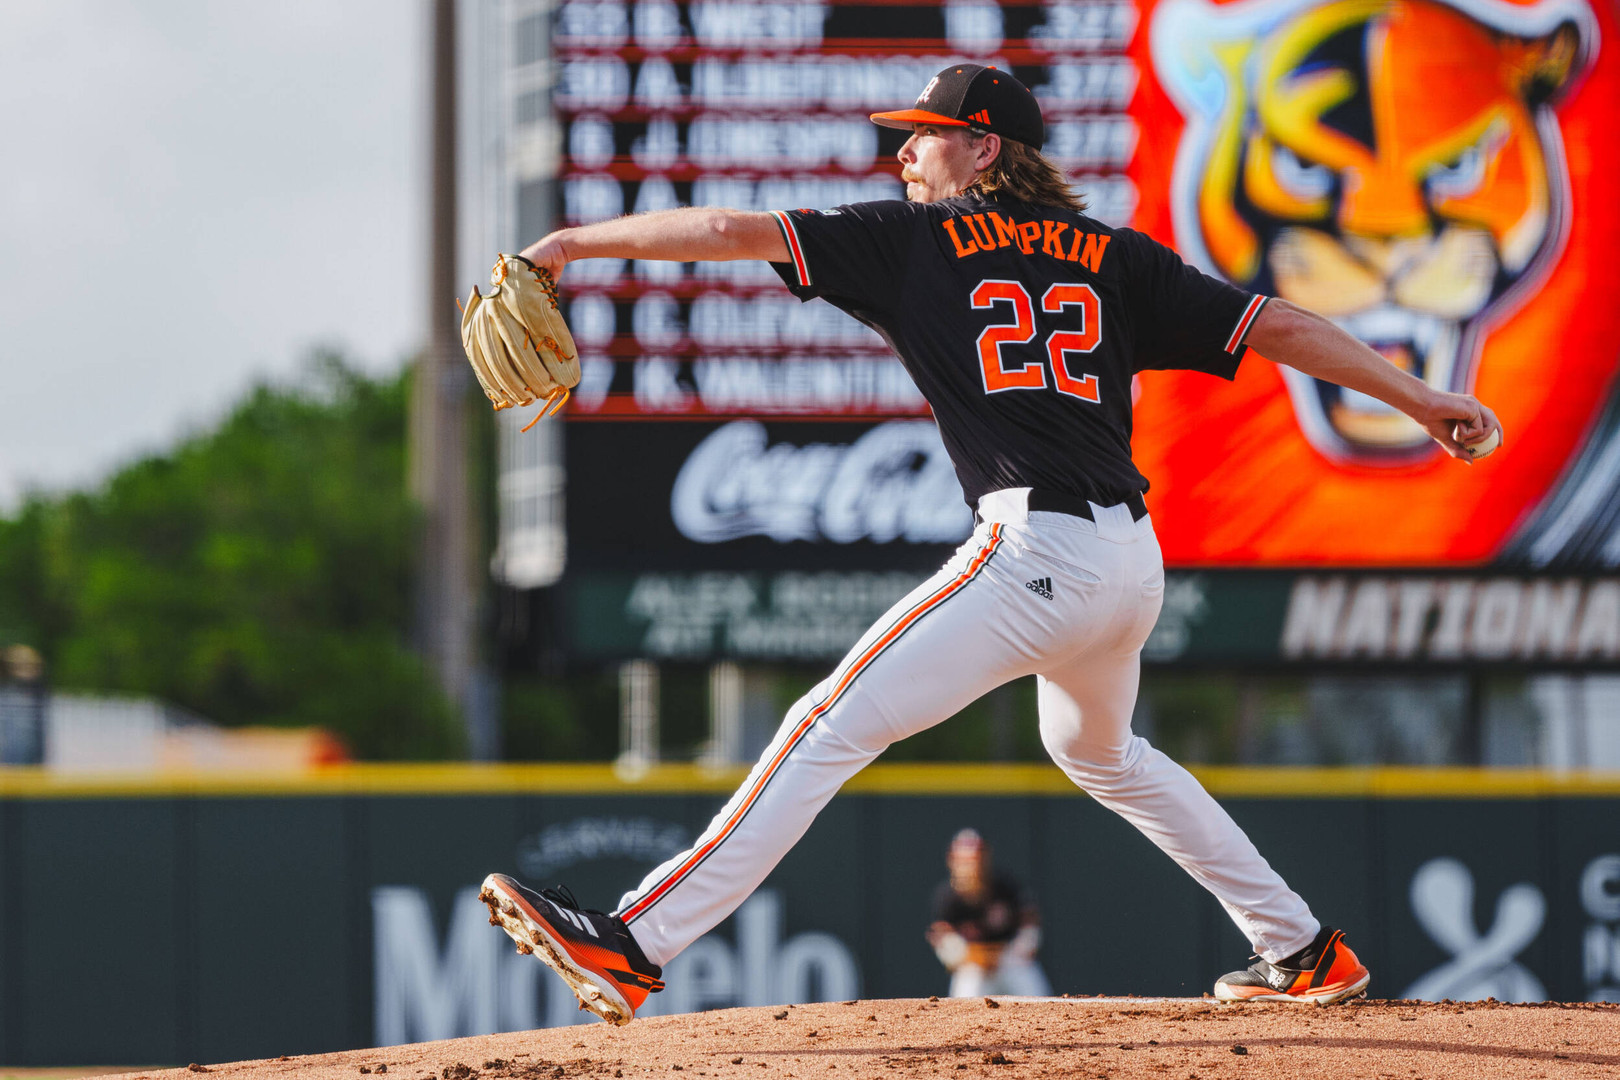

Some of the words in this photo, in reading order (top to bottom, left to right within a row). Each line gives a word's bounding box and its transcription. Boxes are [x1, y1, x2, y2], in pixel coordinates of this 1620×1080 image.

[942, 211, 1111, 274] LUMPKIN
[970, 279, 1101, 404] 22
[1025, 581, 1055, 601] adidas
[371, 885, 862, 1047] Moelo
